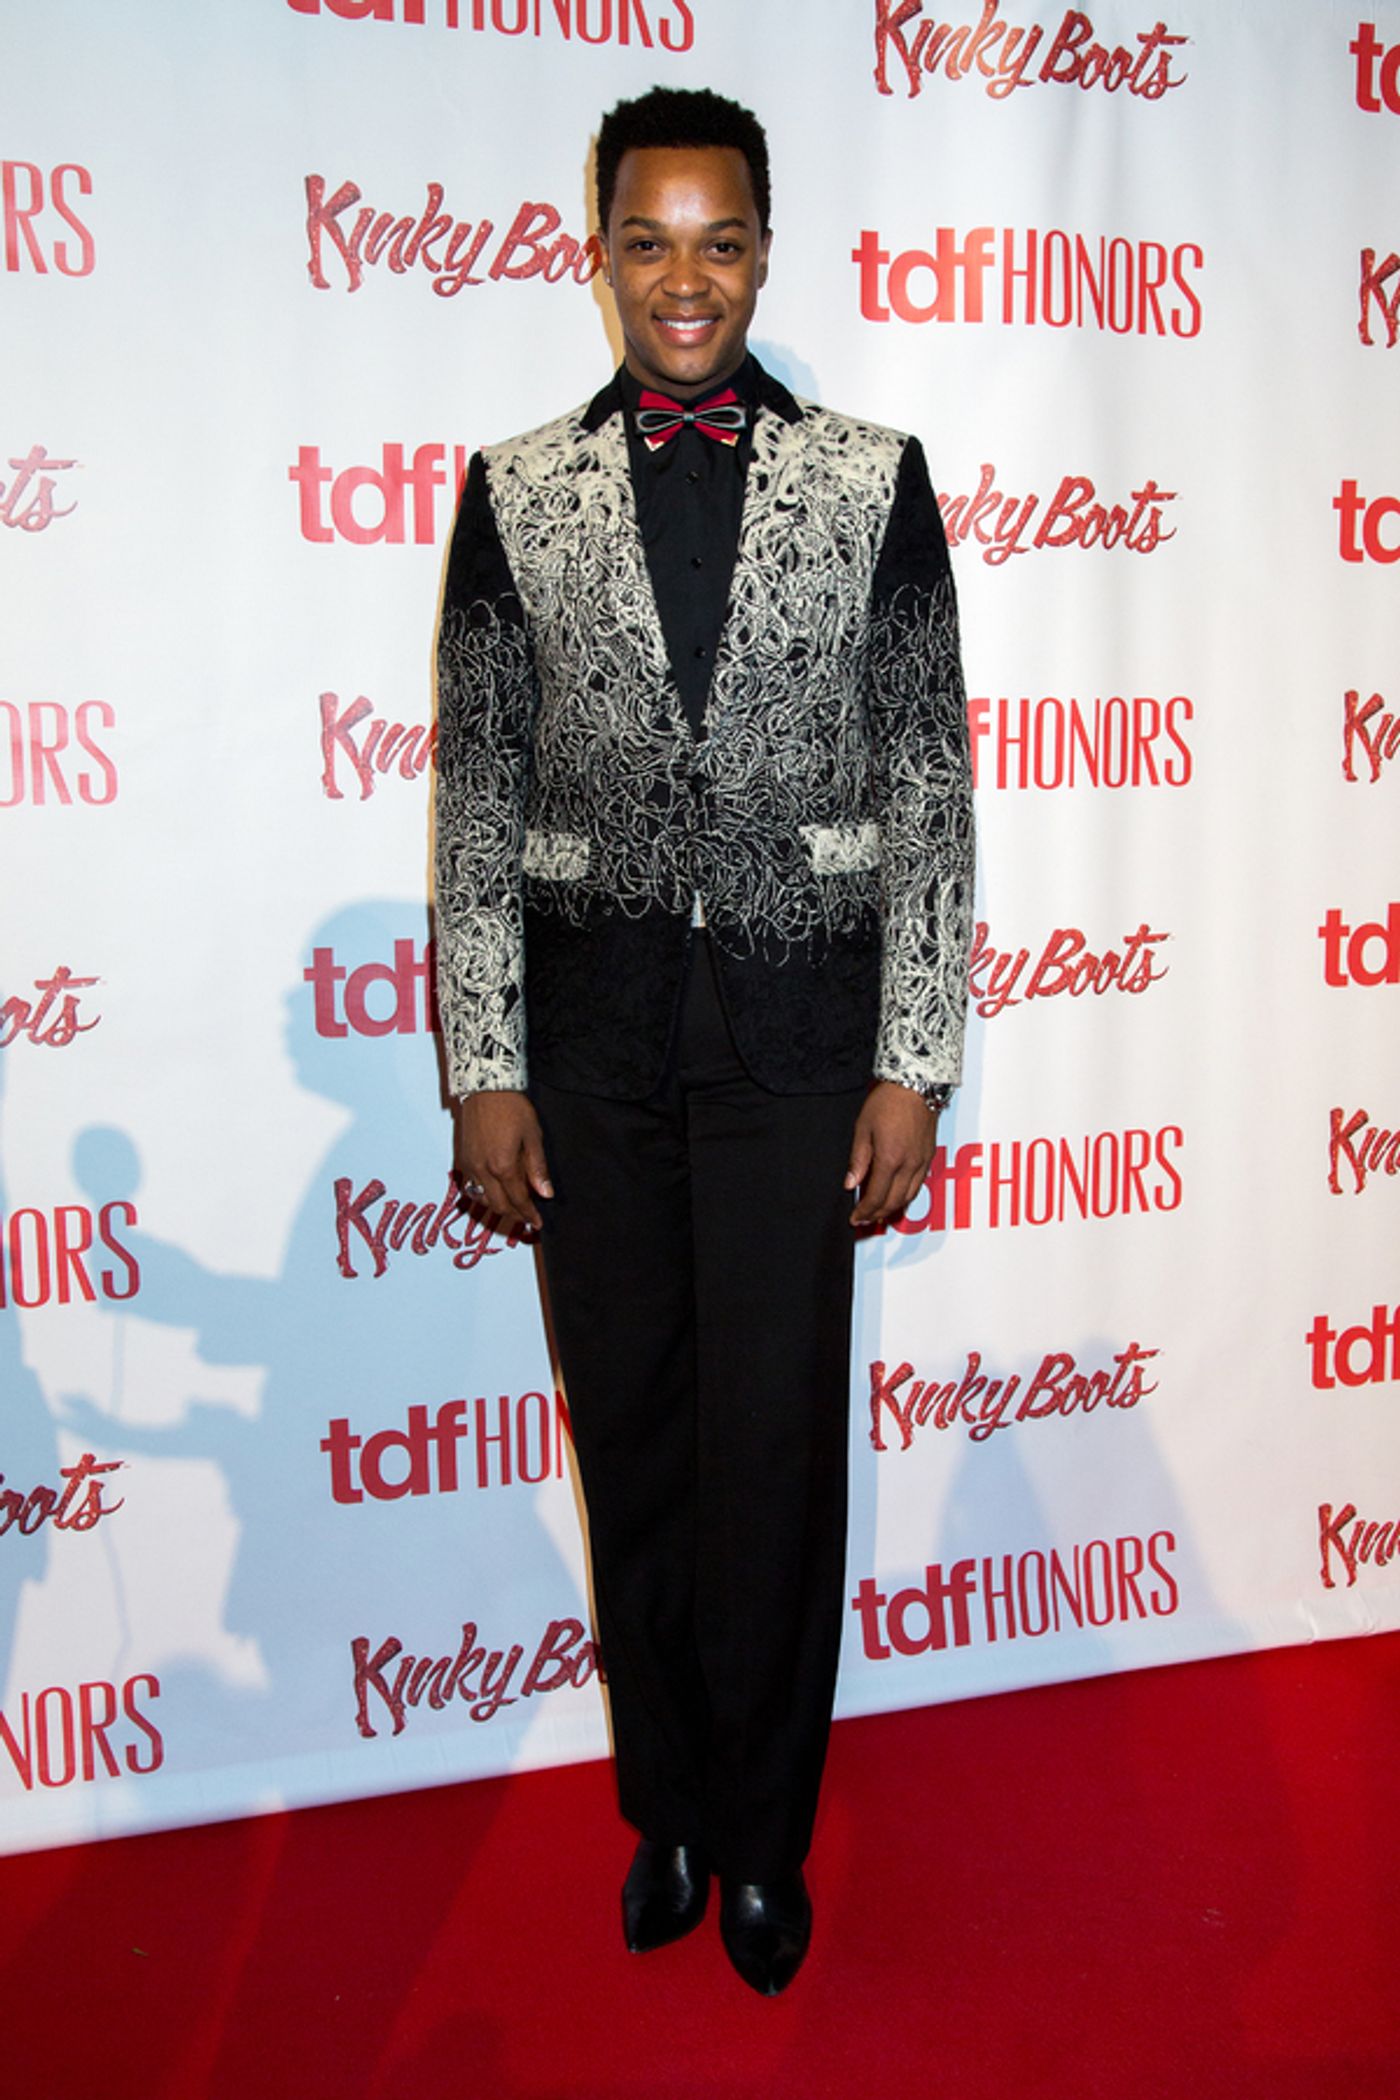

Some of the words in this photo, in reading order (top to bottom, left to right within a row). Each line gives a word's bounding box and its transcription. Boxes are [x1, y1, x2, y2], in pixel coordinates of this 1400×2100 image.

[874, 0, 1042, 99] Kinky
[1039, 9, 1187, 100] Boots
[307, 175, 492, 298] Kinky
[851, 227, 995, 324] tdf
[1002, 228, 1204, 339] HONORS
[0, 444, 78, 533] ts
[288, 443, 446, 545] tdf
[1033, 476, 1178, 554] Boots
[996, 696, 1194, 790] HONORS
[1025, 923, 1170, 1000] Boots
[988, 1125, 1184, 1229] HONORS
[0, 1202, 140, 1310] ORS
[869, 1351, 1021, 1451] Kinky
[1016, 1342, 1159, 1420] Boots
[0, 1453, 125, 1534] oots
[320, 1400, 468, 1504] tdf
[852, 1558, 976, 1660] tdf
[982, 1530, 1179, 1643] HONORS
[1318, 1503, 1400, 1589] Kin
[351, 1622, 523, 1738] Kinky
